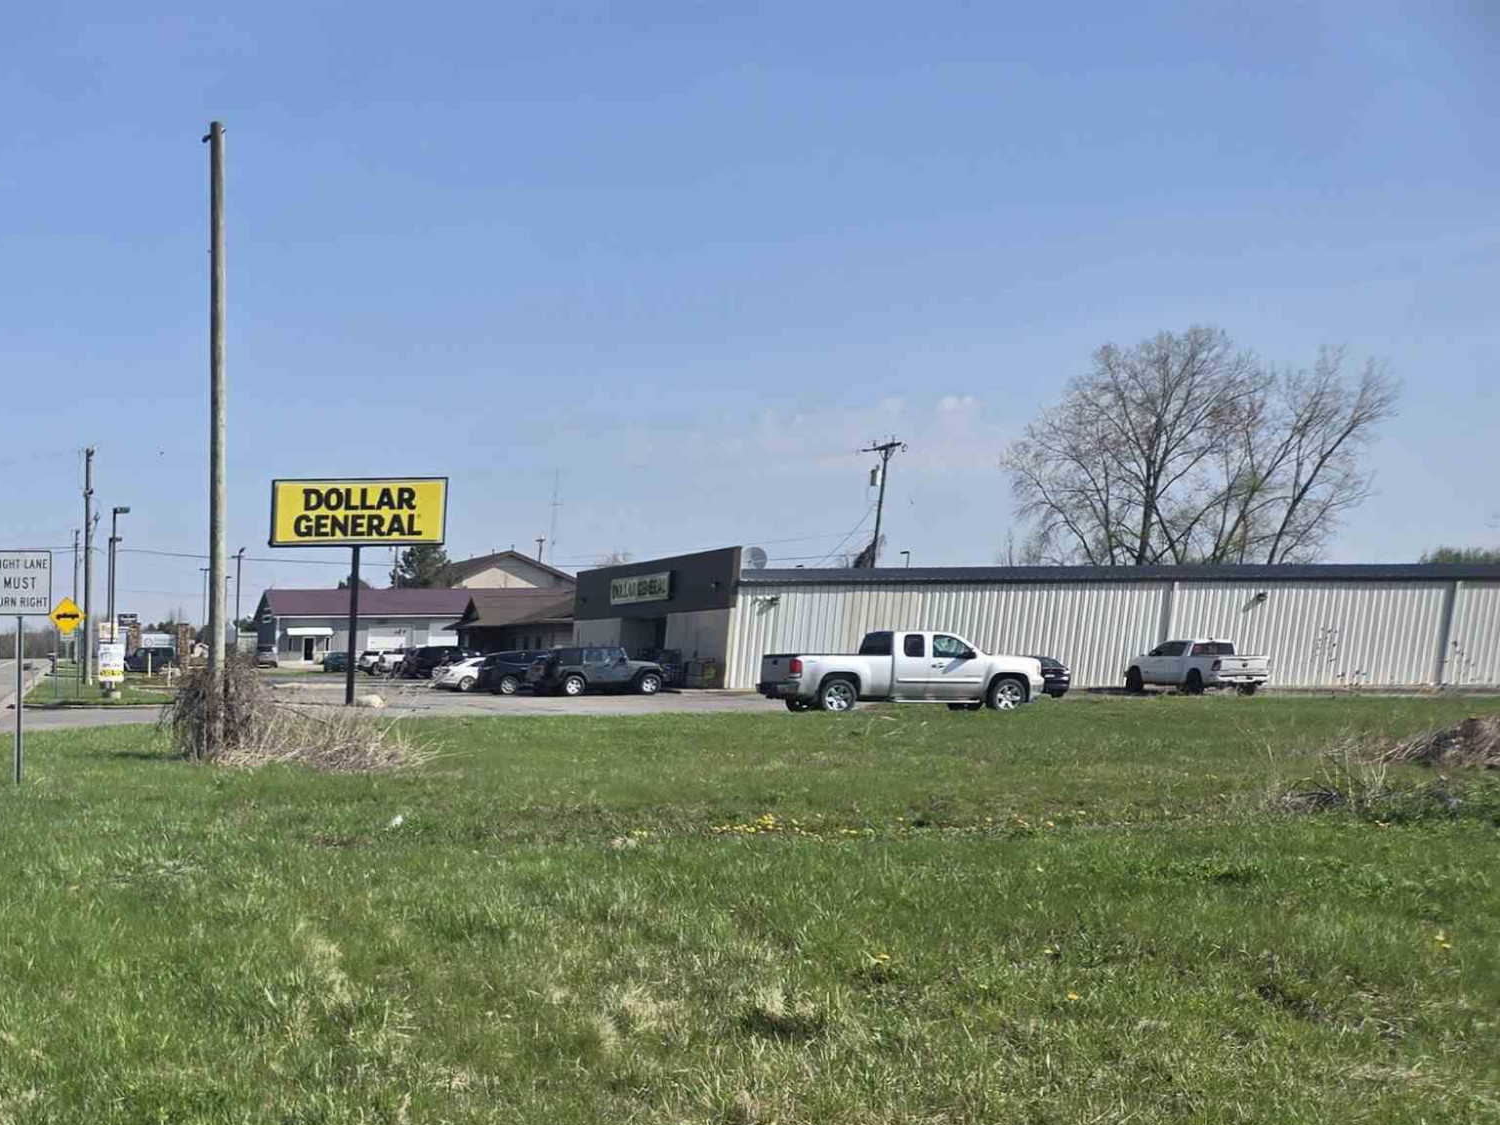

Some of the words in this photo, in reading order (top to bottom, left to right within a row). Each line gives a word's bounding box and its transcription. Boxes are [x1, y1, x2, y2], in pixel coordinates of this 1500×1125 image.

[303, 487, 417, 511] DOLLAR
[294, 514, 422, 537] GENERAL
[24, 559, 48, 569] LANE
[3, 577, 36, 589] MUST
[20, 596, 47, 607] RIGHT
